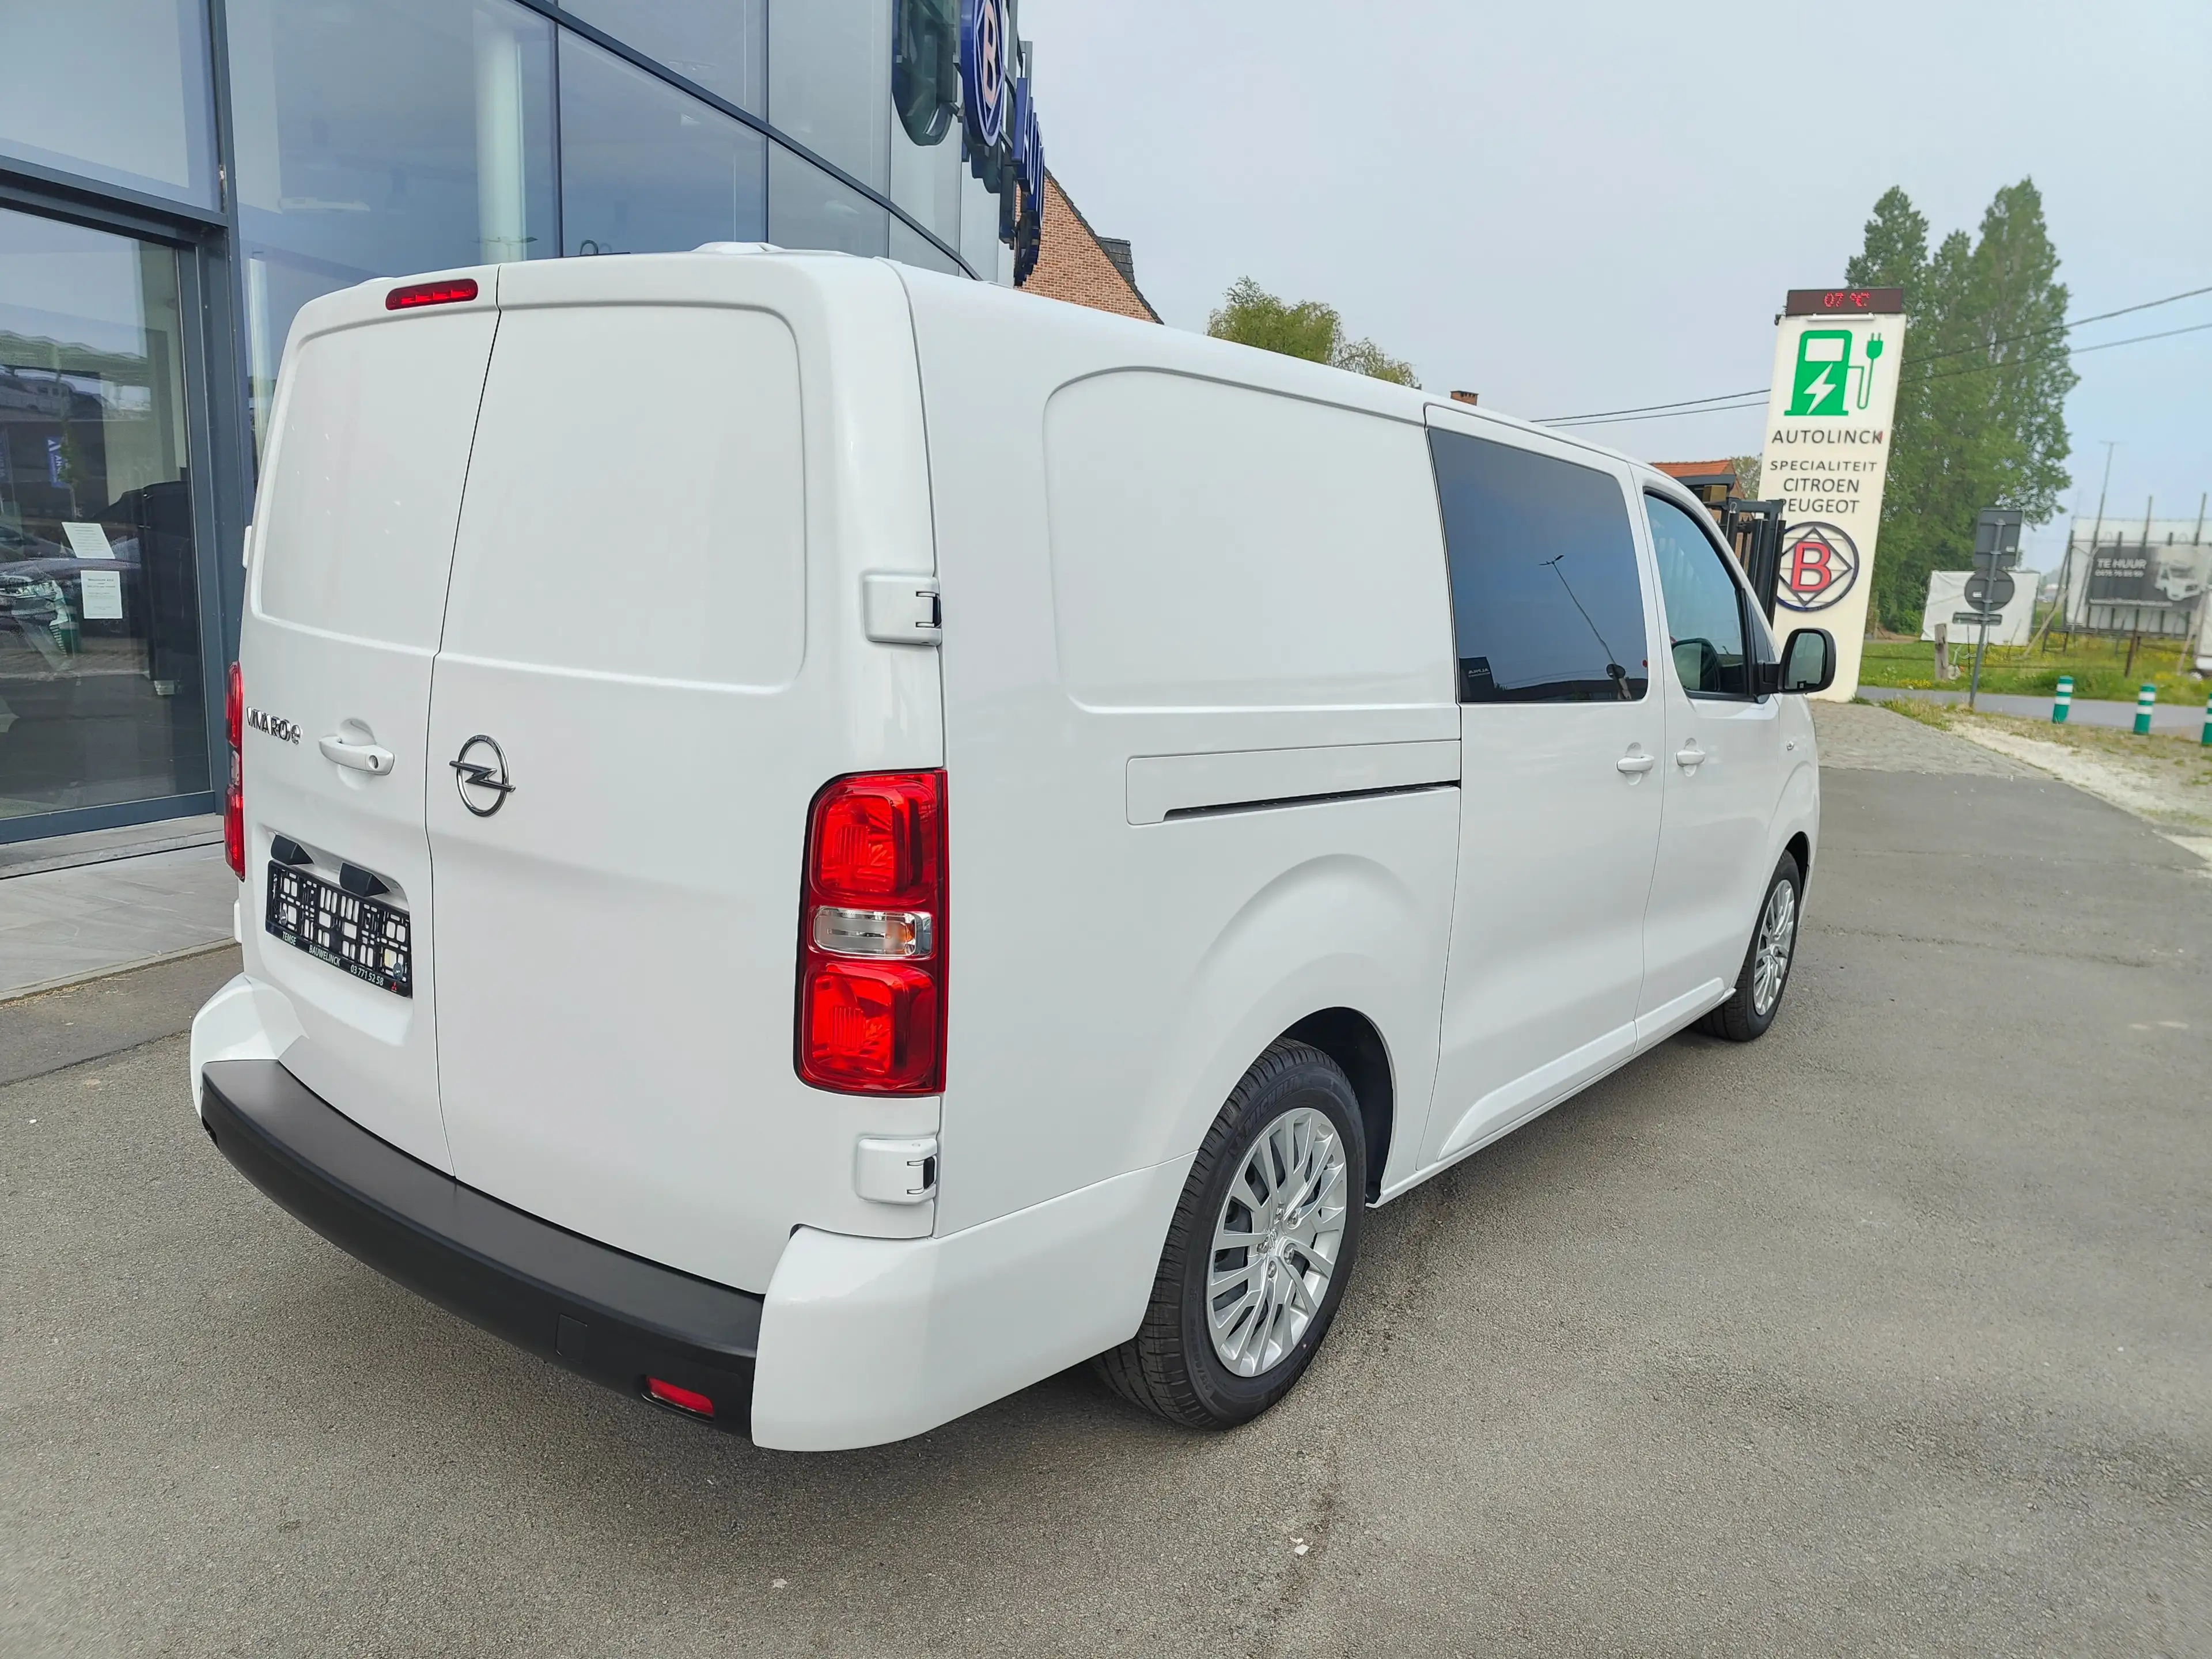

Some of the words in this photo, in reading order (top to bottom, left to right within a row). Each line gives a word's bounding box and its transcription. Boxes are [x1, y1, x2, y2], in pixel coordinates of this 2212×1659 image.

[983, 1, 997, 109] B
[1824, 292, 1844, 308] 07
[1771, 429, 1884, 445] AUTOLINCK
[1770, 460, 1877, 472] SPECIALITEIT
[1783, 478, 1859, 493] CITROEN
[1791, 541, 1832, 592] B
[2097, 558, 2112, 569] TE
[2112, 558, 2147, 569] HUUR
[282, 931, 297, 946] TEMSE
[309, 944, 341, 967] BAUWELINCK
[350, 964, 358, 975] 03
[358, 968, 368, 979] 771
[368, 972, 376, 983] 52
[376, 976, 384, 986] 58
